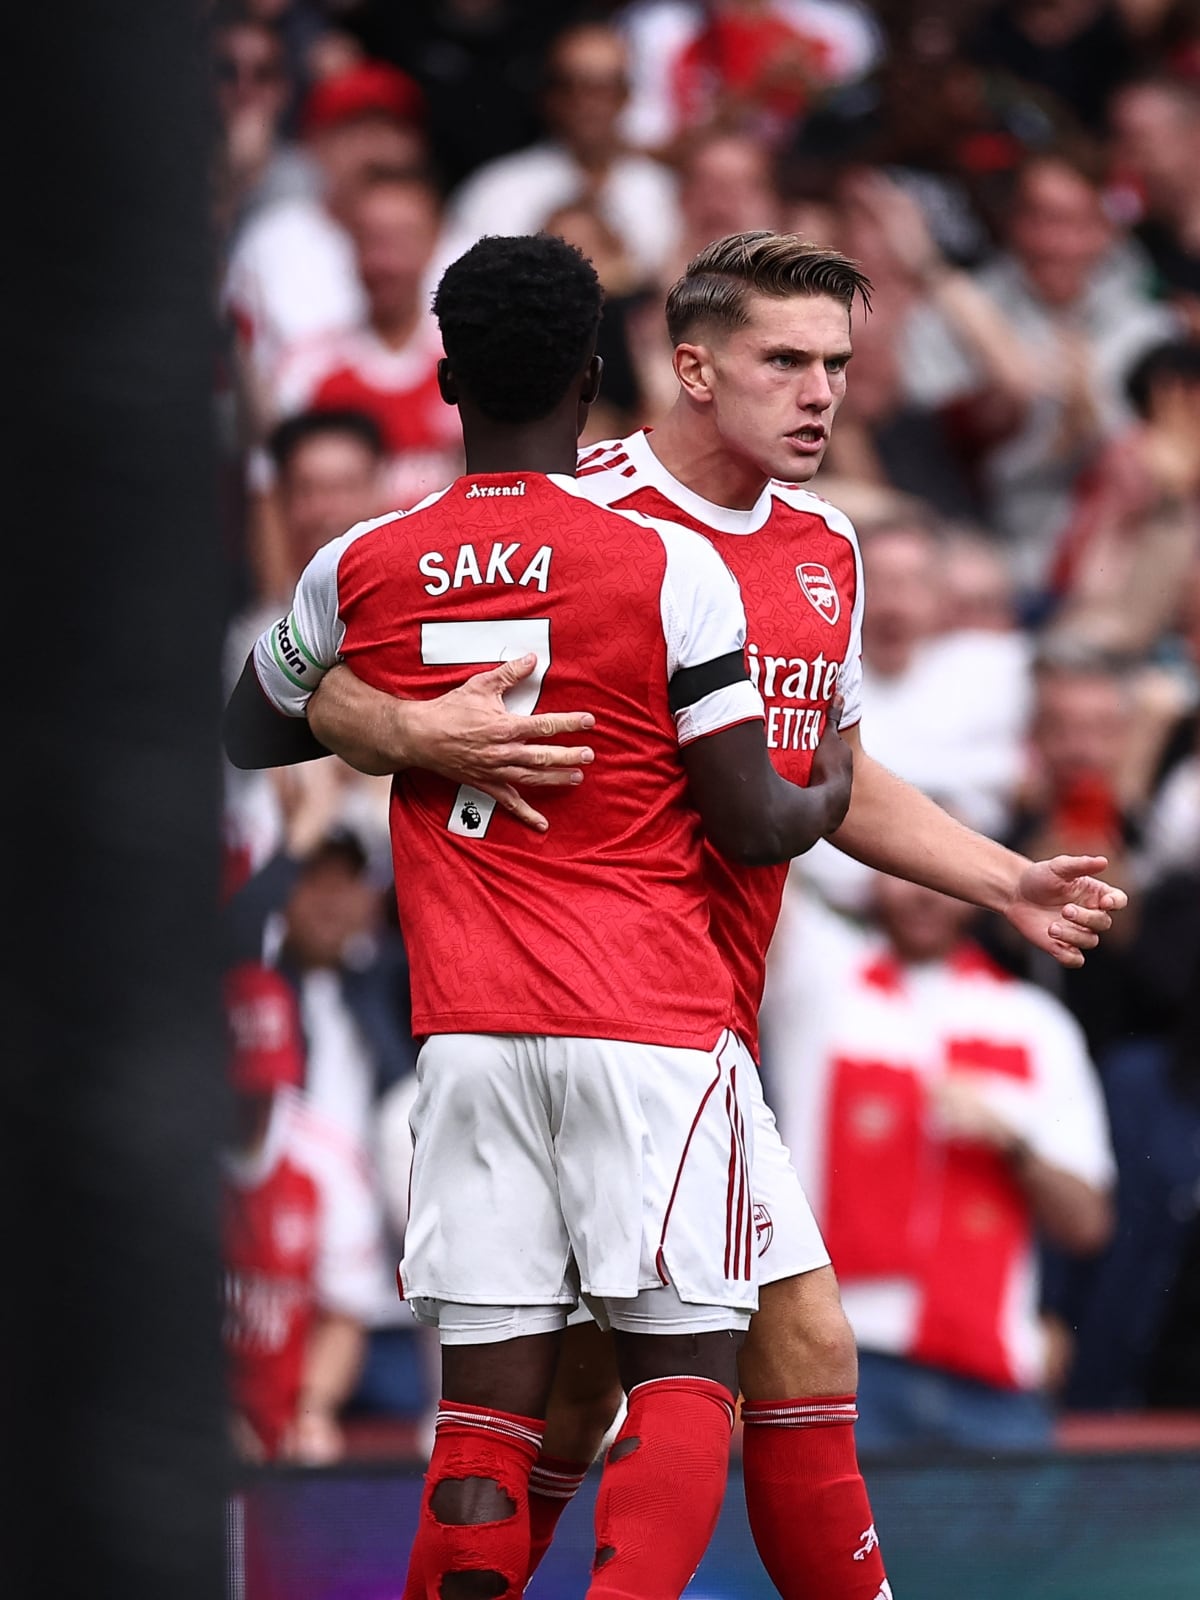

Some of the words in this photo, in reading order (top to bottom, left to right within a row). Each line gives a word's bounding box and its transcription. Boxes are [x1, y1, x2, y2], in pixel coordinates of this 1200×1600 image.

[465, 480, 526, 499] Arsenal
[418, 542, 553, 597] SAKA
[747, 643, 842, 702] irate
[420, 617, 552, 839] 7
[766, 706, 823, 751] ETTER
